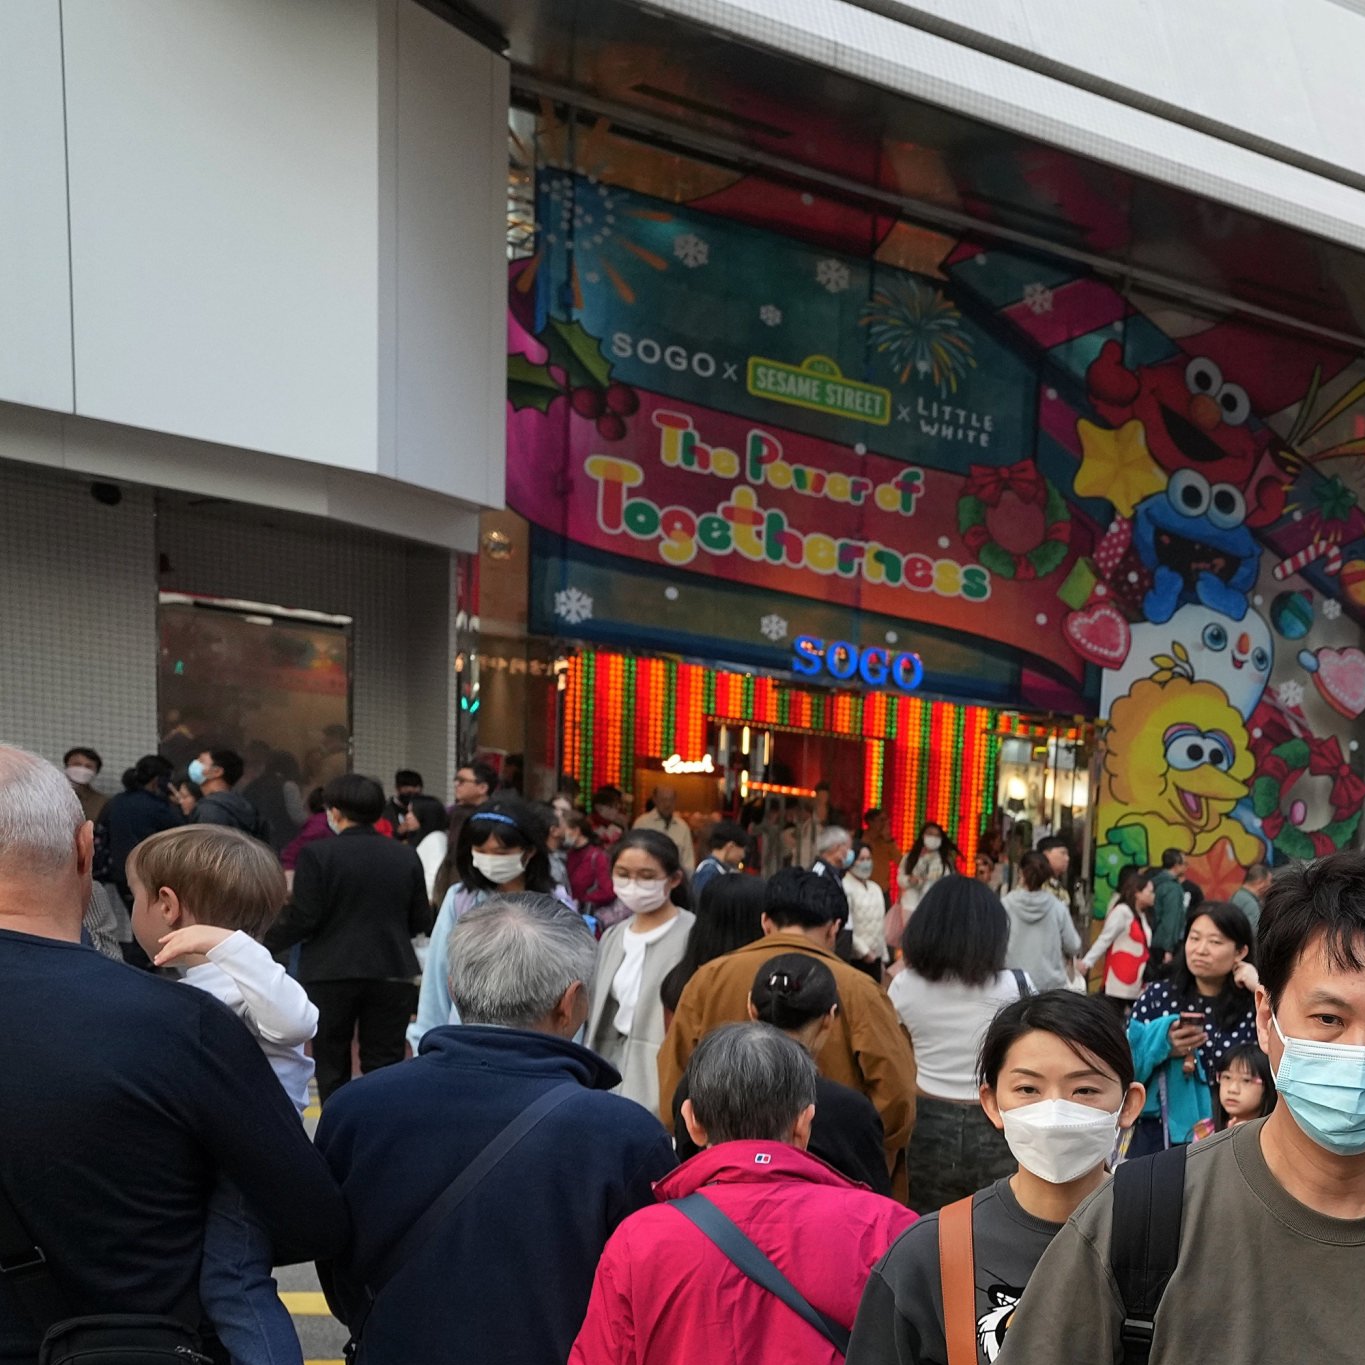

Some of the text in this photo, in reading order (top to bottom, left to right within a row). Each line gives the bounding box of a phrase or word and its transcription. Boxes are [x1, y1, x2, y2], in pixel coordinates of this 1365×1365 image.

[611, 332, 716, 377] SOGO
[756, 367, 821, 402] SESAME
[825, 383, 883, 416] STREET
[916, 397, 993, 432] LITTLE
[920, 419, 991, 448] WHITE
[653, 410, 924, 515] The Power of
[584, 456, 992, 602] Togetherness
[792, 635, 924, 690] SOGO
